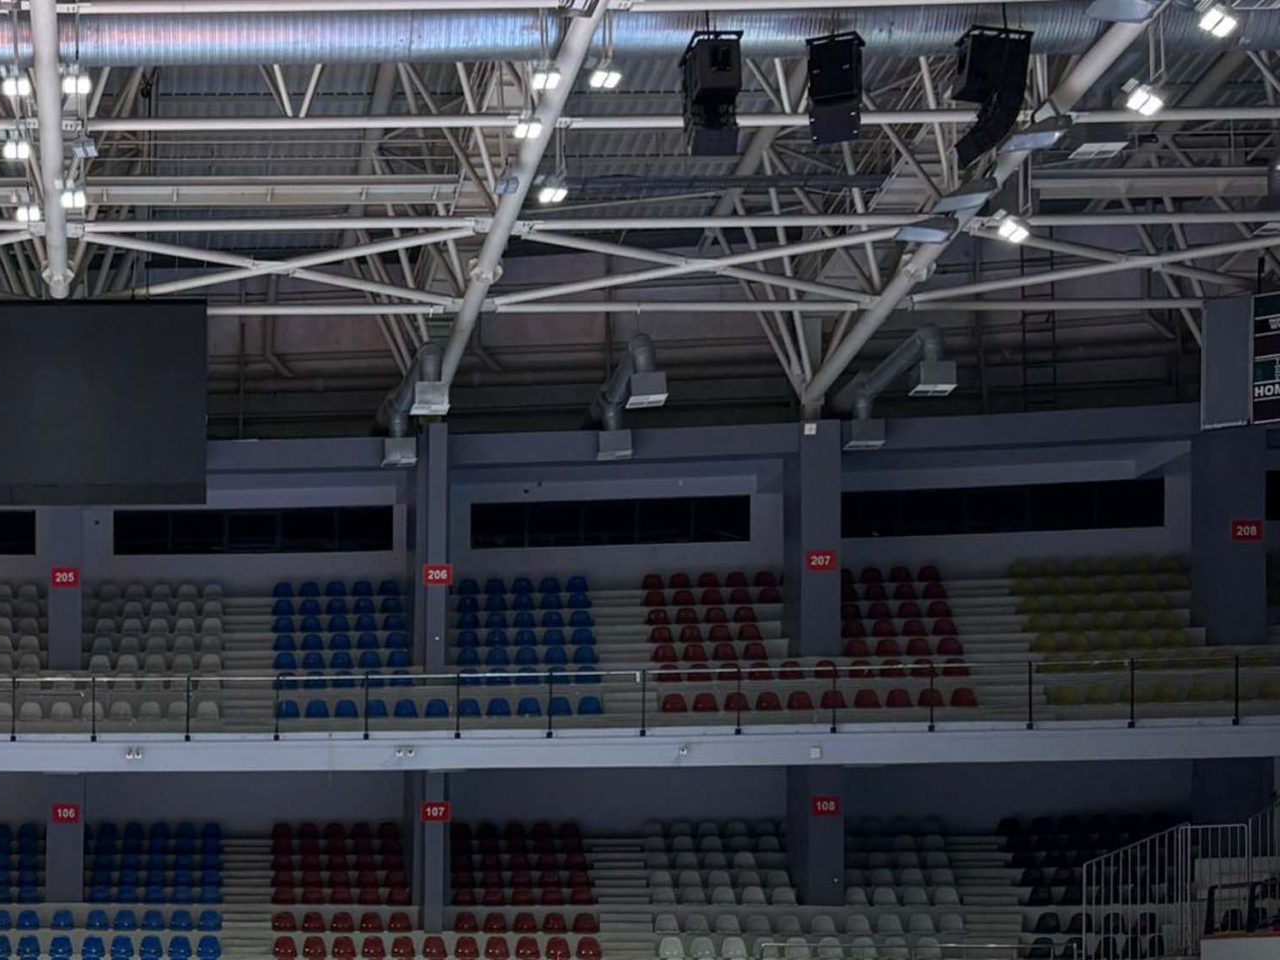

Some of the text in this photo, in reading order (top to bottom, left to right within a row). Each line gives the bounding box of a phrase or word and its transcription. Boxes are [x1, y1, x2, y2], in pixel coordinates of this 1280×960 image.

[1236, 525, 1257, 536] 208
[811, 555, 831, 567] 207
[56, 571, 75, 583] 205
[427, 569, 448, 580] 206
[57, 808, 75, 818] 106
[426, 806, 446, 817] 107
